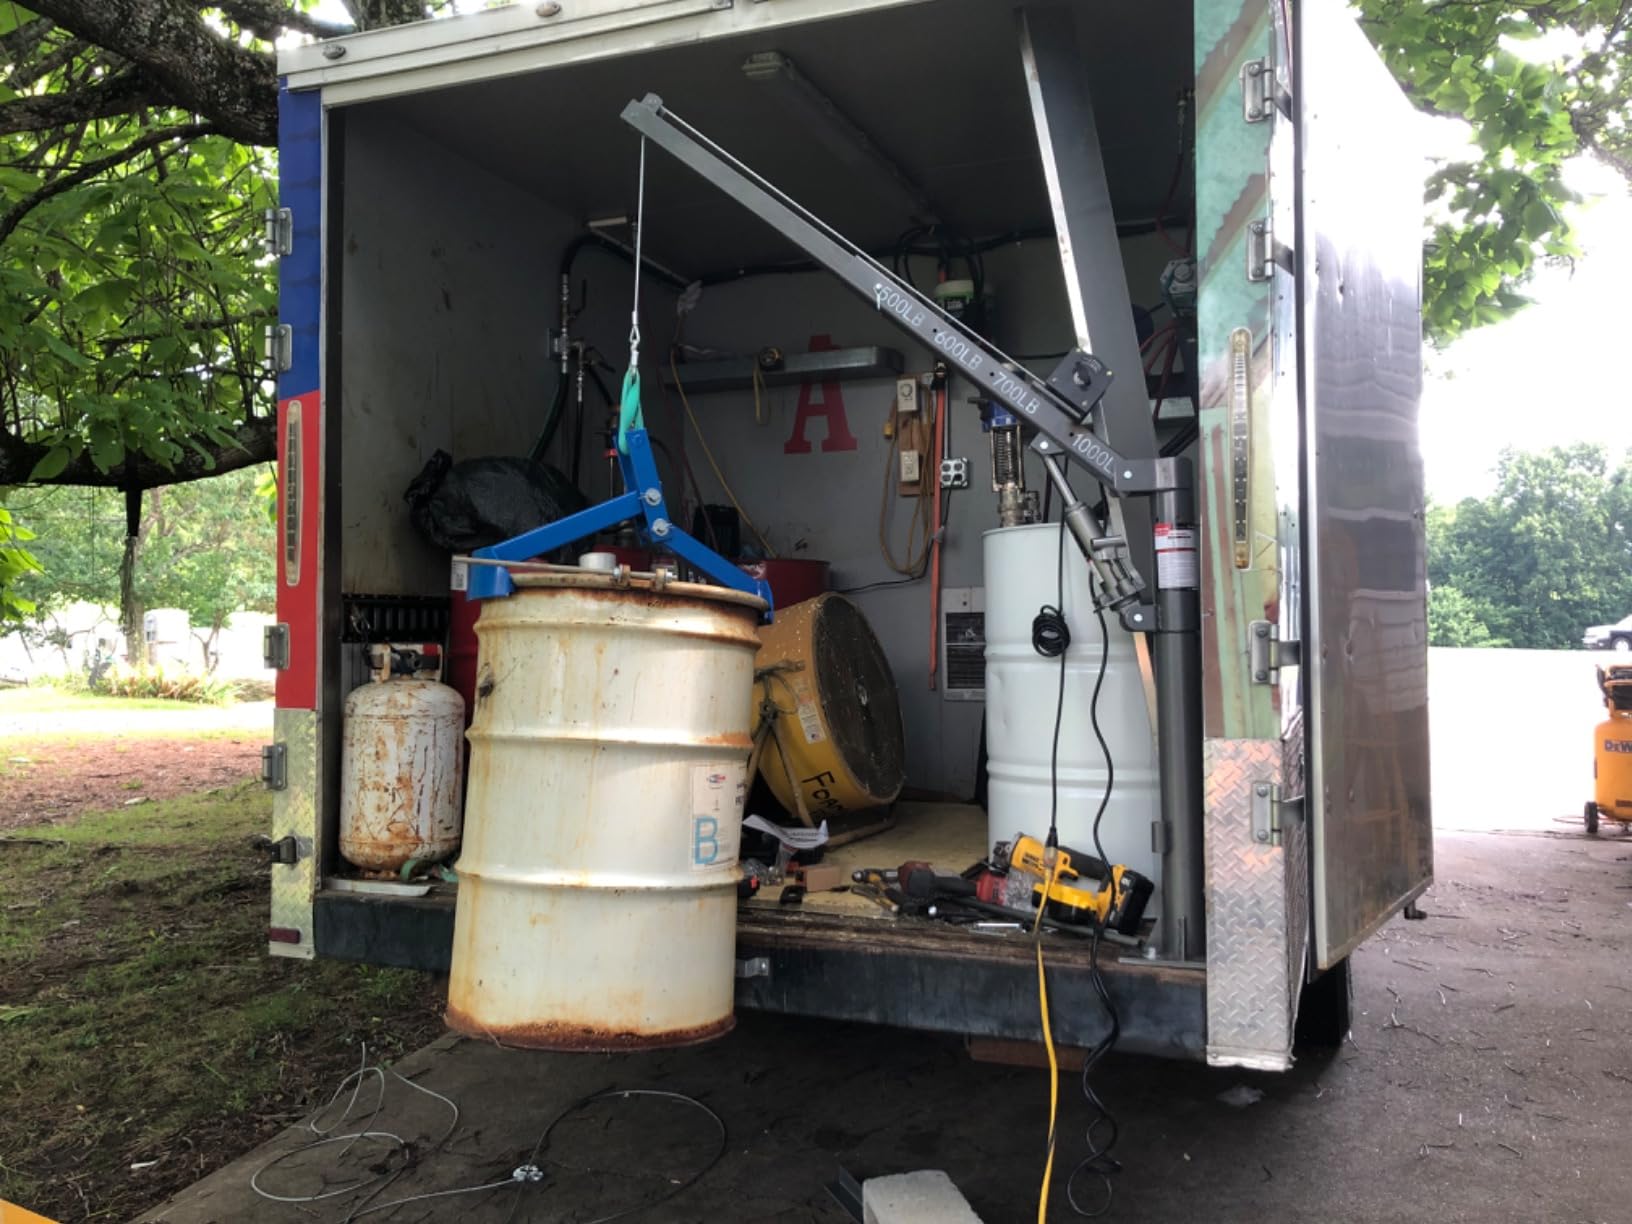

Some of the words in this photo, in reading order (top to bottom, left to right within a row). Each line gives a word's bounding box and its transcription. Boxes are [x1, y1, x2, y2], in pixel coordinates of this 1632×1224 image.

[879, 286, 926, 326] 500LB
[934, 331, 983, 370] 600LB
[784, 335, 858, 453] A
[991, 371, 1040, 414] 700LB
[693, 815, 719, 865] B
